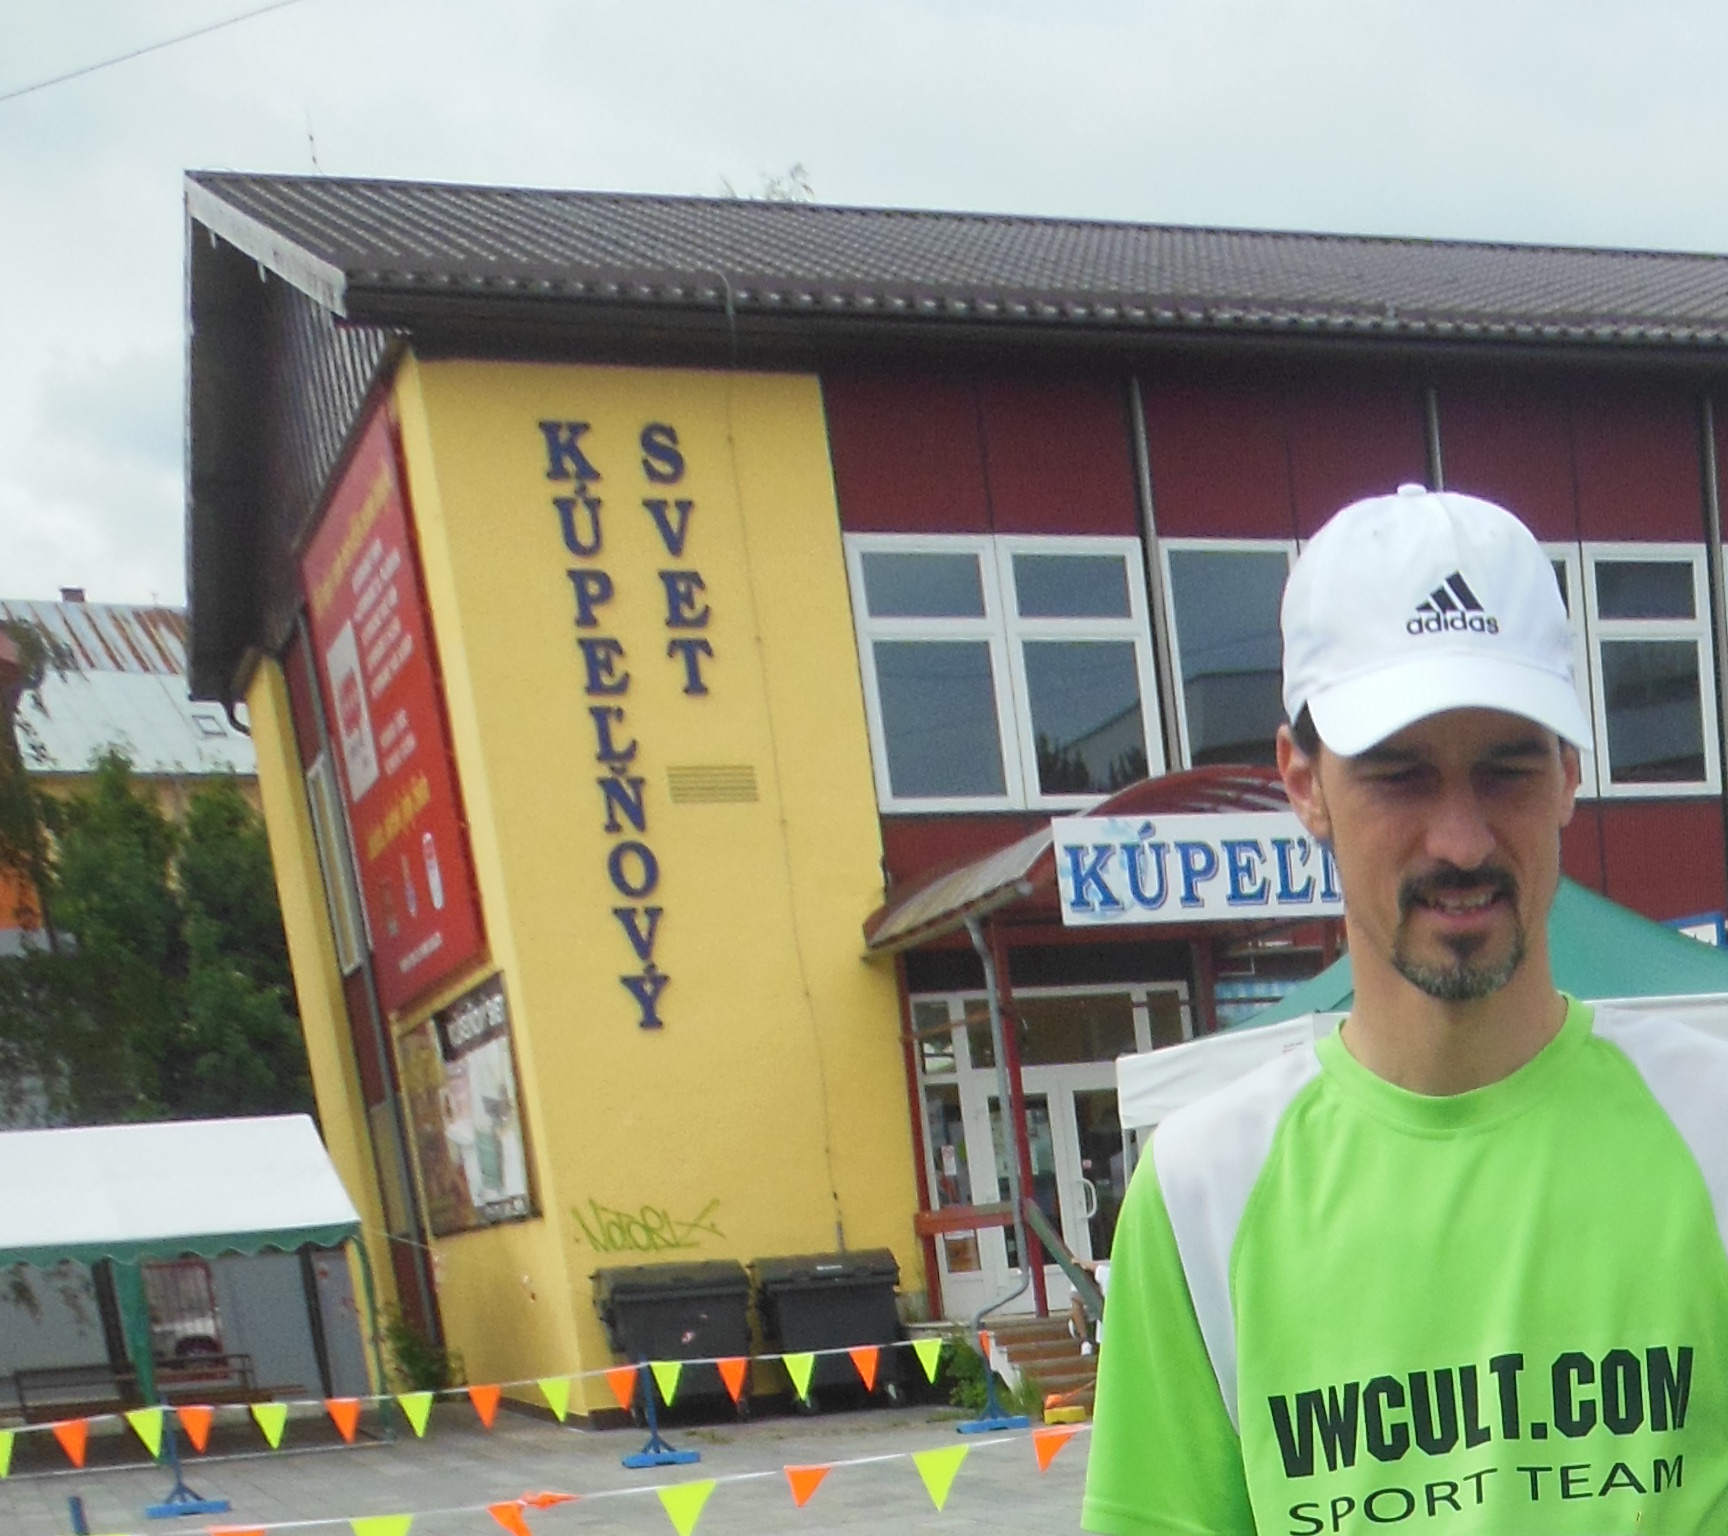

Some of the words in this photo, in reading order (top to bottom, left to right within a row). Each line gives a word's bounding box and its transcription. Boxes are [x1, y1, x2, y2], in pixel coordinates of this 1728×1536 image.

[640, 422, 713, 697] SVET
[1406, 611, 1500, 635] adidas
[1288, 1467, 1498, 1536] SPORT
[1516, 1454, 1684, 1501] TEAM
